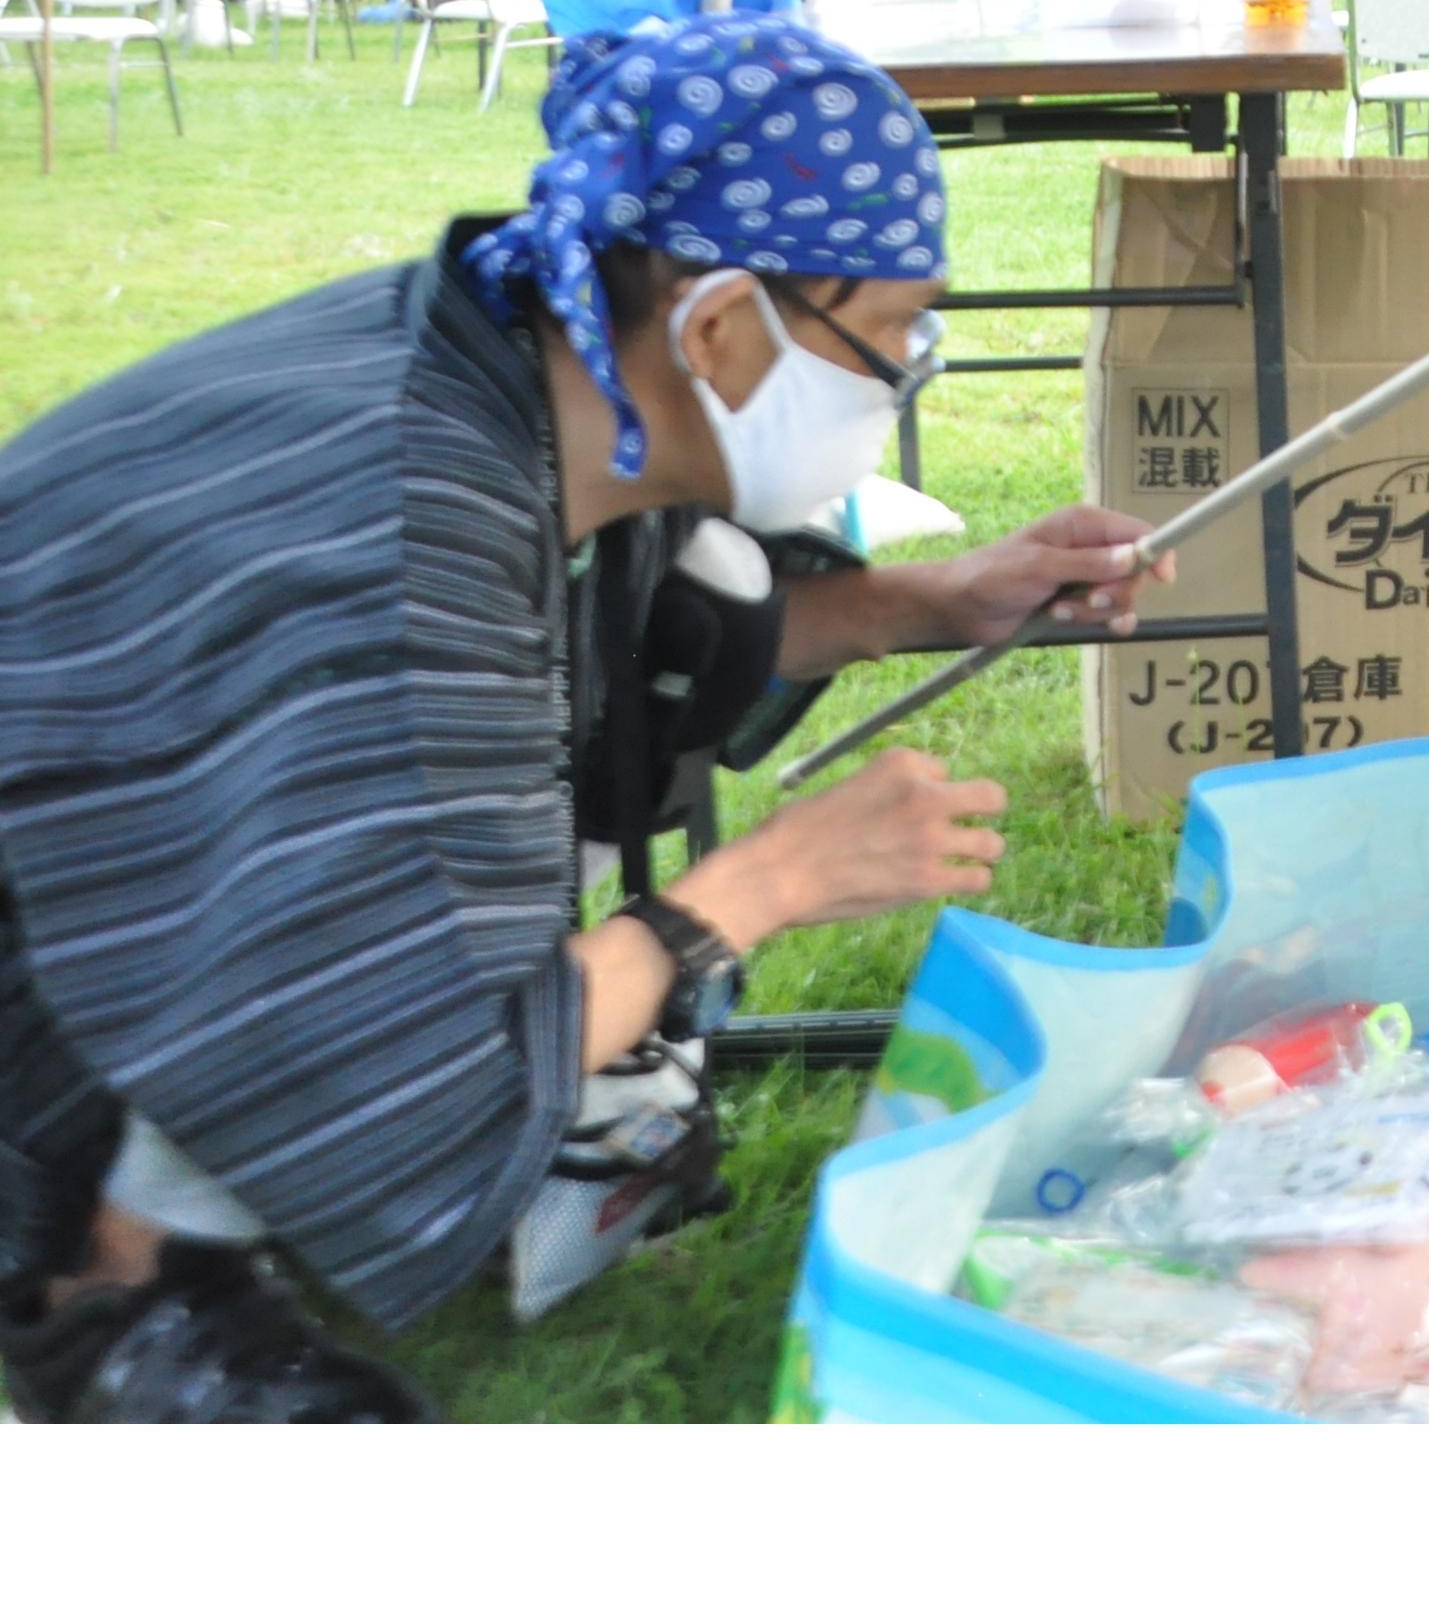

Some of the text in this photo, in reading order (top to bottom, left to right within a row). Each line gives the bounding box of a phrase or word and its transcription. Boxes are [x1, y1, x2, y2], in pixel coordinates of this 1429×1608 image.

[1137, 394, 1222, 439] MIX
[1137, 446, 1223, 488] 混載
[1129, 654, 1403, 707] J-20倉庫
[1167, 715, 1364, 755] (J-27)
